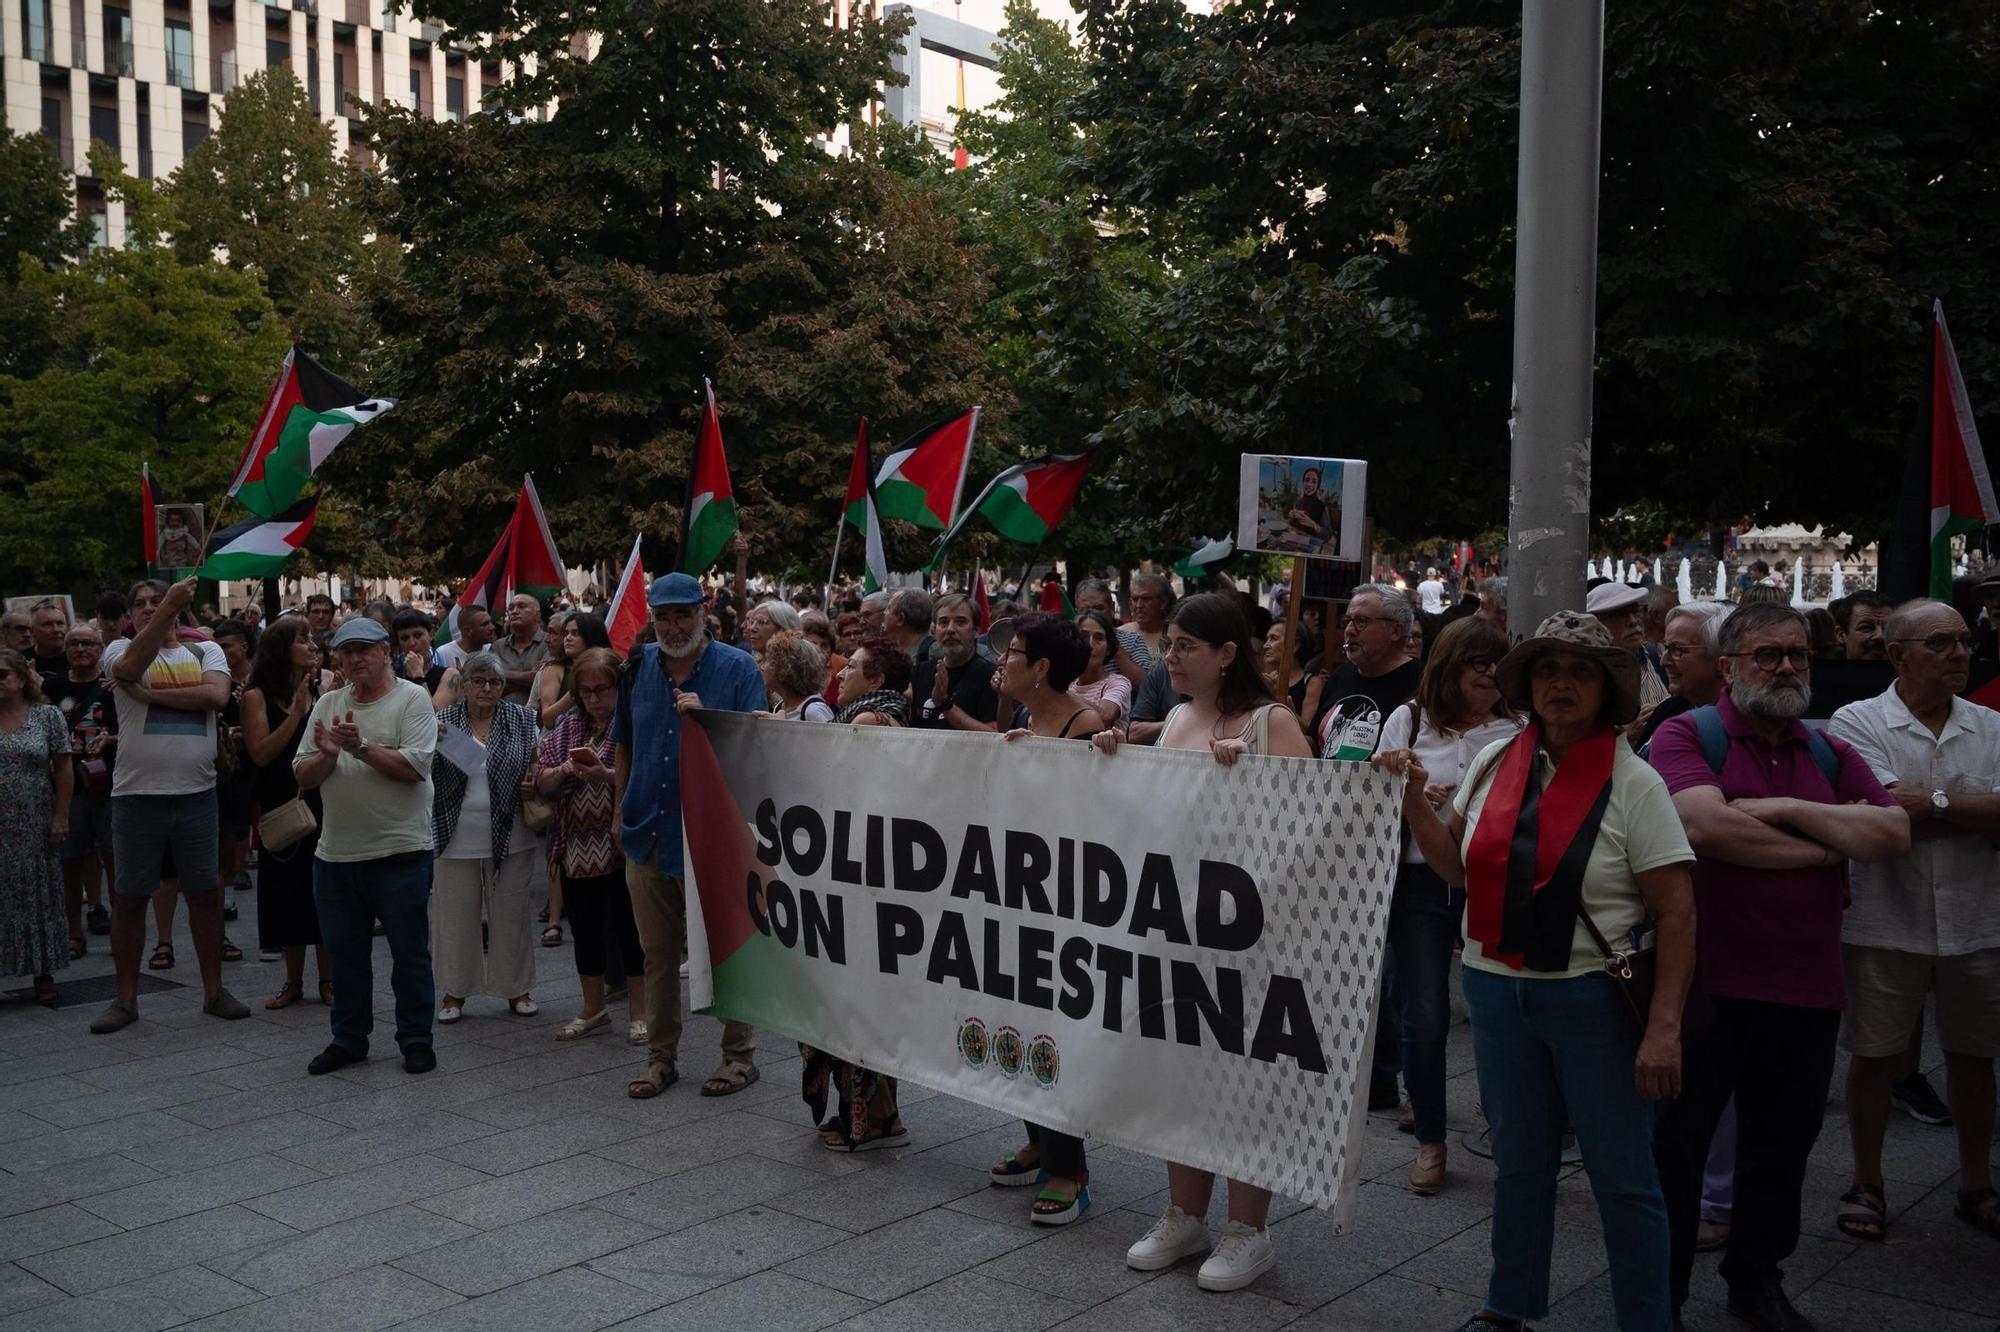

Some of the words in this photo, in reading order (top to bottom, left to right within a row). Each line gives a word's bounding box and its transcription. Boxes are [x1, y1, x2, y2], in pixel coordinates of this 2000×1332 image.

[755, 797, 1264, 951] SOLIDARIDAD
[747, 871, 846, 965] CON
[876, 902, 1328, 1074] PALESTINA
